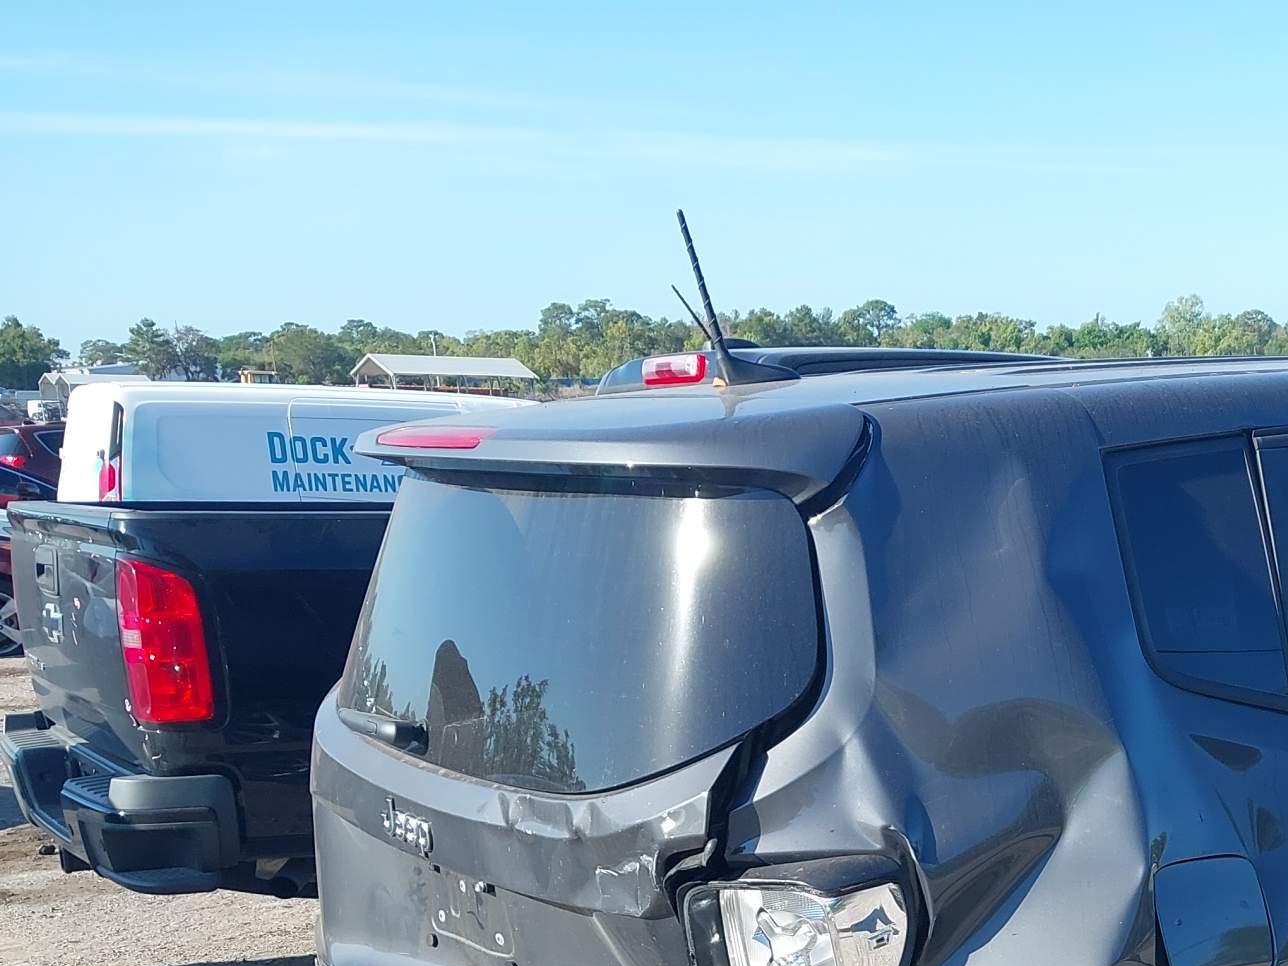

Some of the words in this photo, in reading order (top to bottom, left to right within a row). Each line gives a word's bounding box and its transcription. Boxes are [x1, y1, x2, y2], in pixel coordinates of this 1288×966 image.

[267, 432, 352, 465] DOCK
[271, 470, 404, 493] MAINTENAN
[379, 795, 434, 858] Jeep
